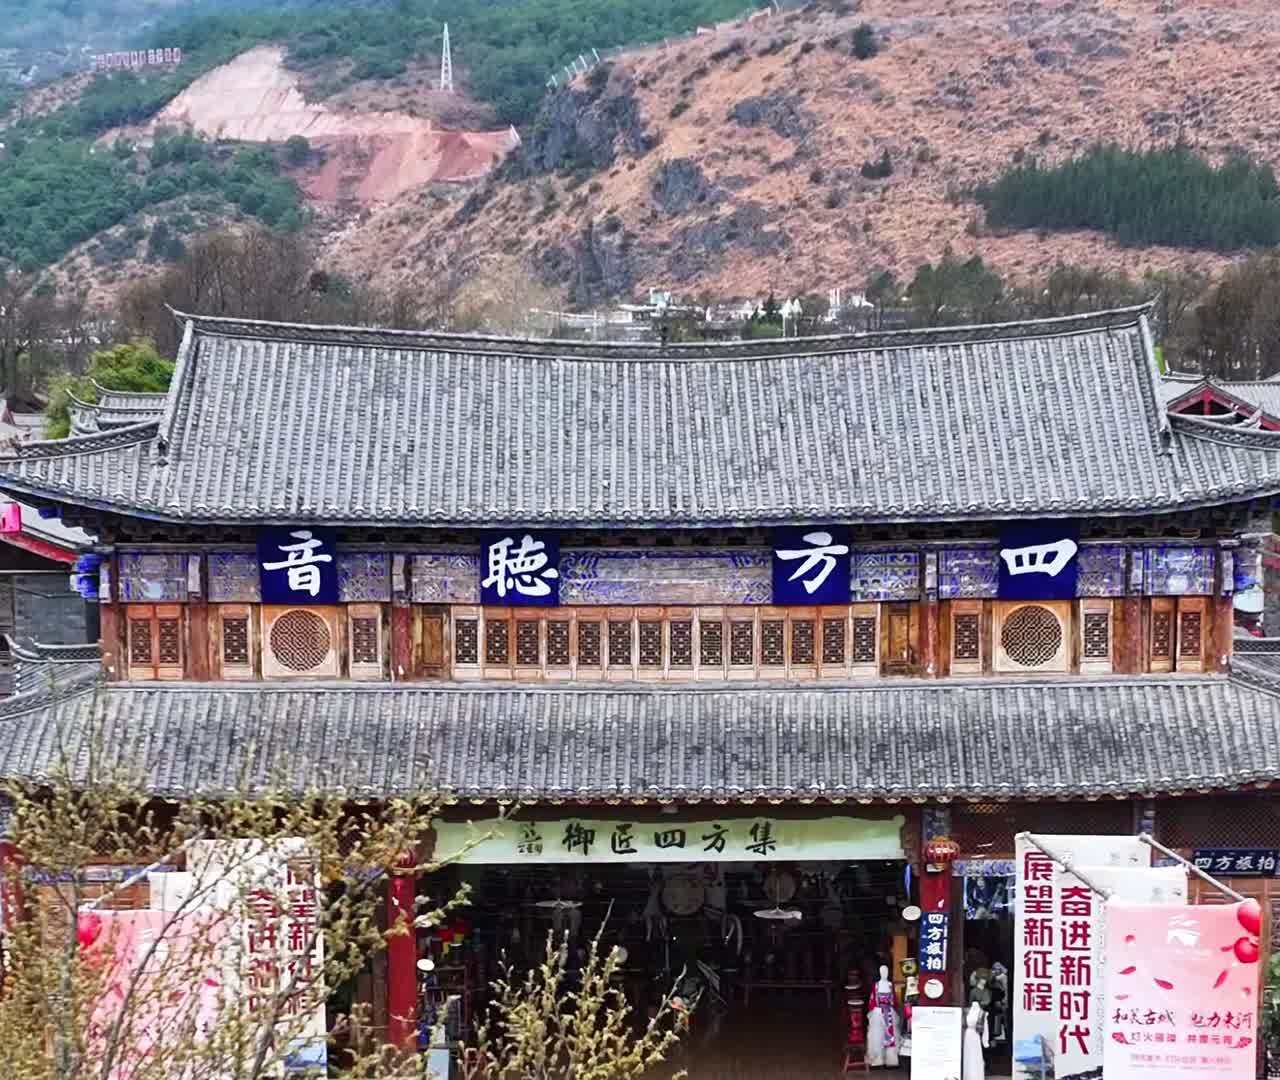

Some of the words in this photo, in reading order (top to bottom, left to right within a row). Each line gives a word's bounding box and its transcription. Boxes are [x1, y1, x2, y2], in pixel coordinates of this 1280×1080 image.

[1023, 852, 1054, 1012] 展望新征程
[1059, 886, 1092, 1055] 奋进新时代
